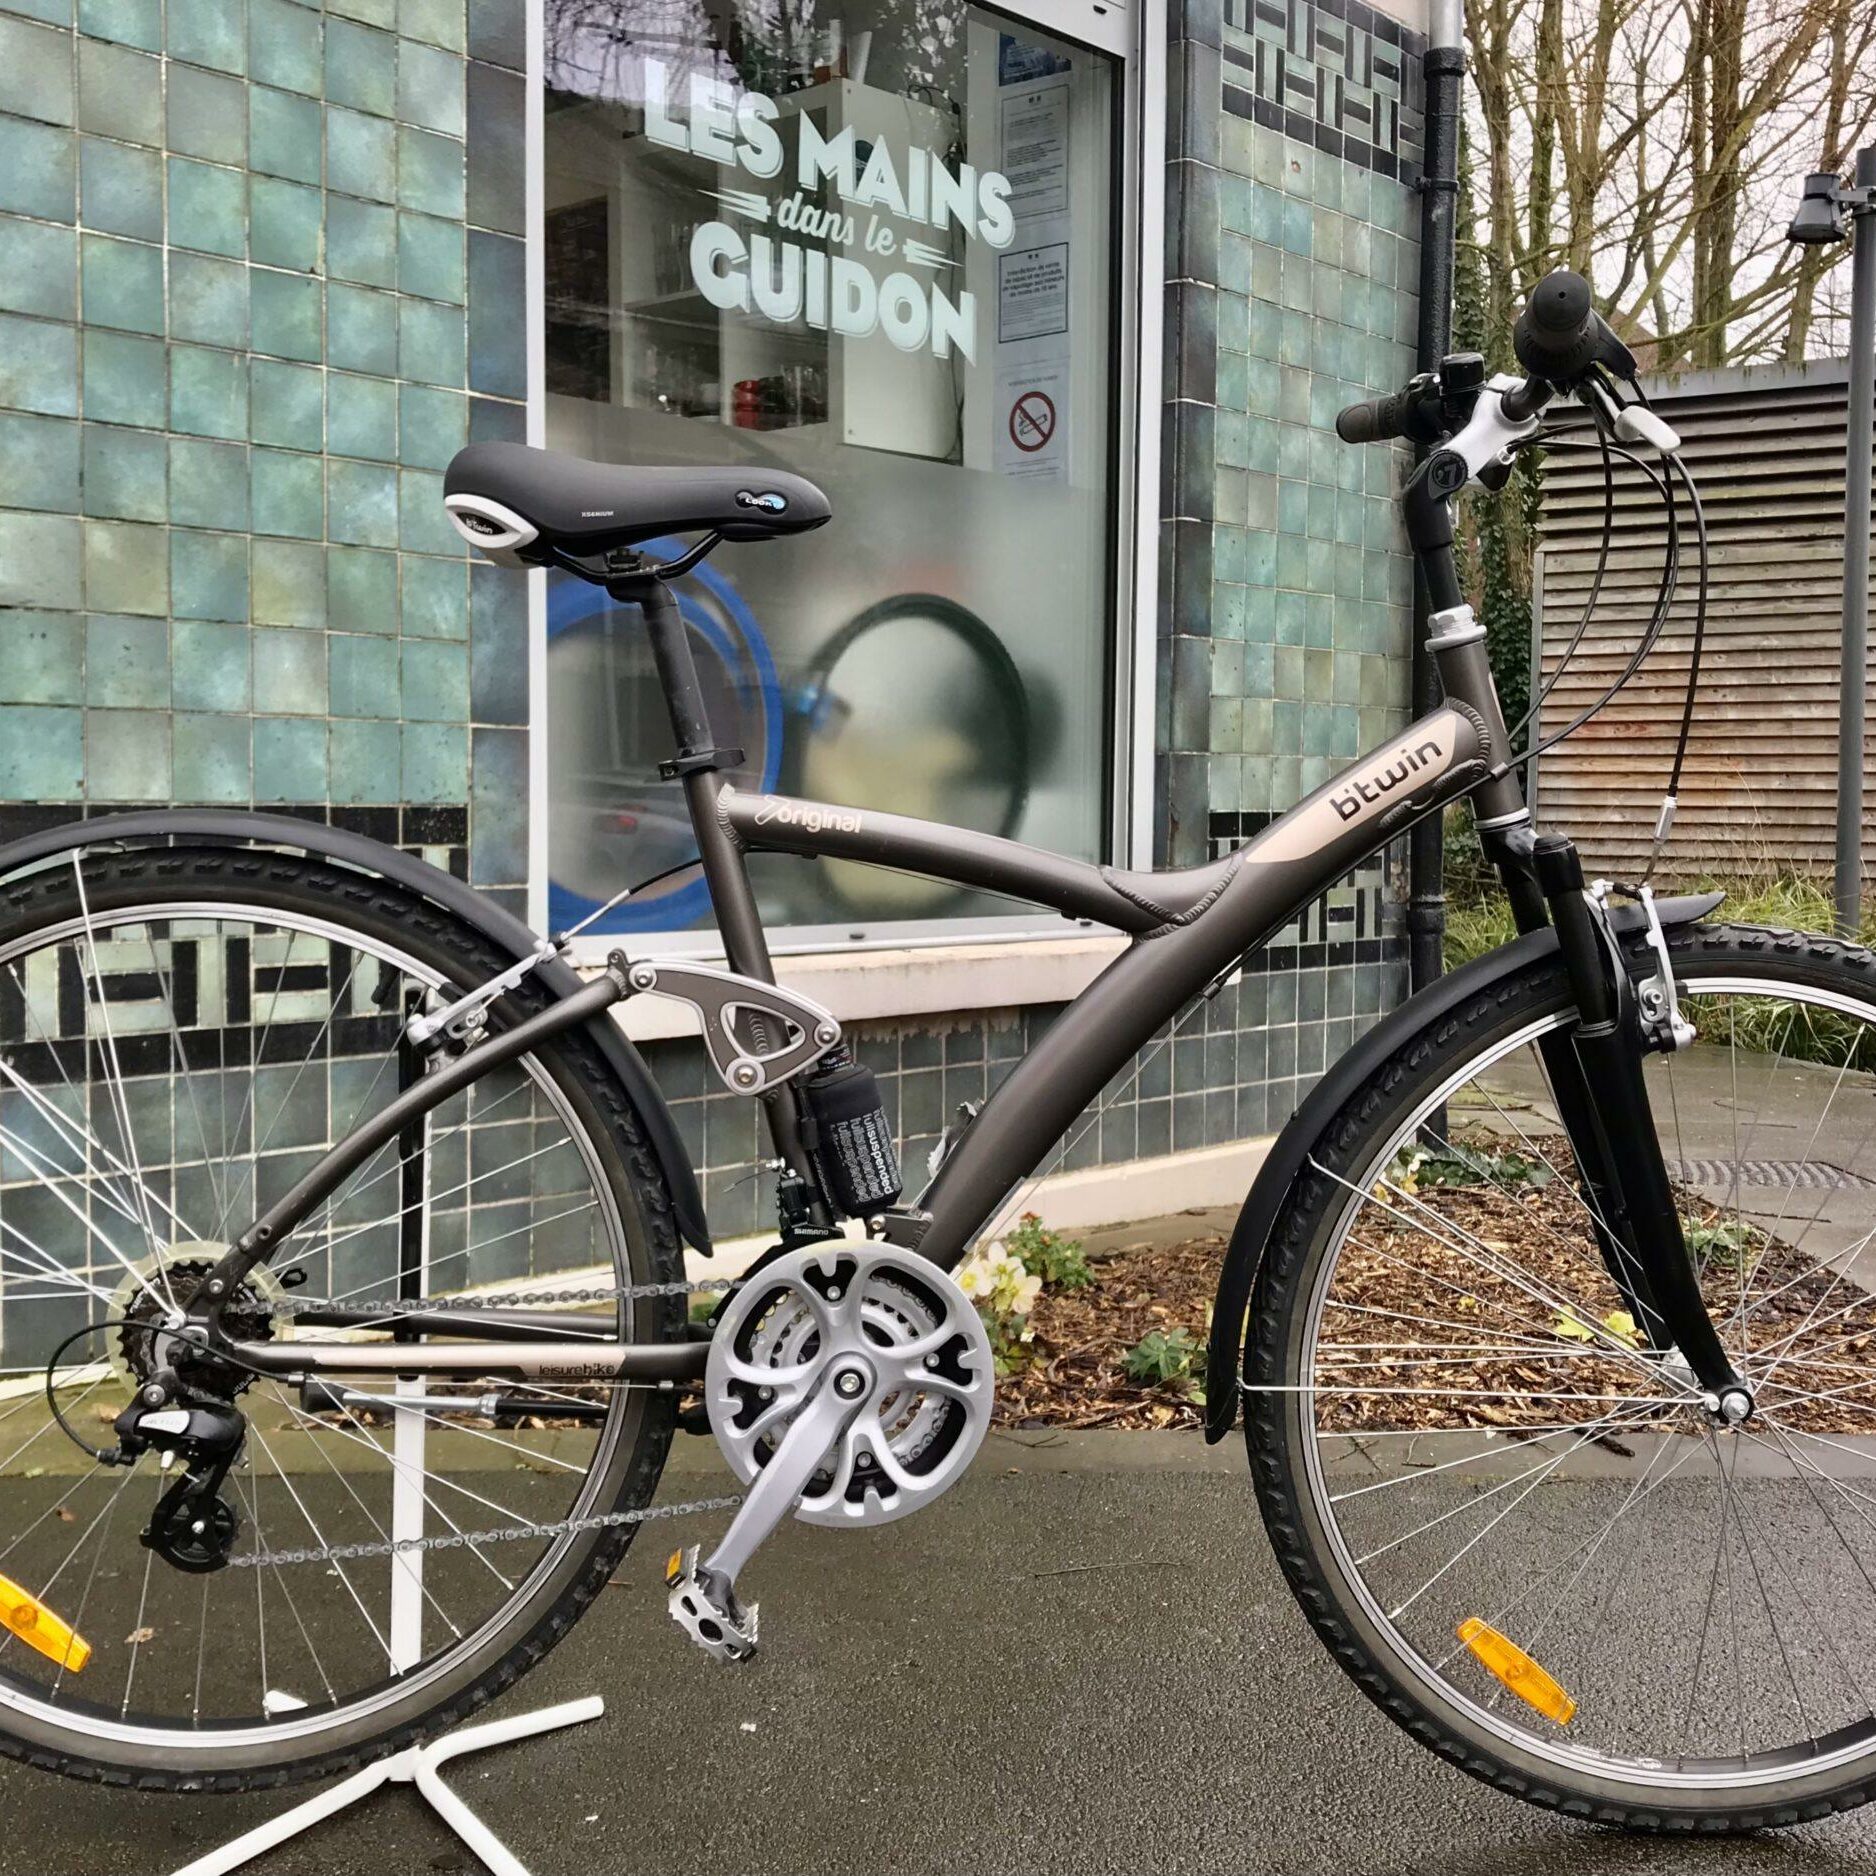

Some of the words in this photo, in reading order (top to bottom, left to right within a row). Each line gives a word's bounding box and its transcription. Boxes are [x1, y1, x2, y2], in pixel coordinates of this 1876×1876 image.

[644, 57, 784, 179] LES
[798, 106, 1016, 249] MAINS
[777, 191, 855, 246] dans
[864, 214, 898, 256] le
[690, 221, 977, 368] GUIDON
[777, 804, 862, 834] original
[862, 1112, 894, 1195] fullsuspended
[538, 1363, 615, 1376] leisurebike
